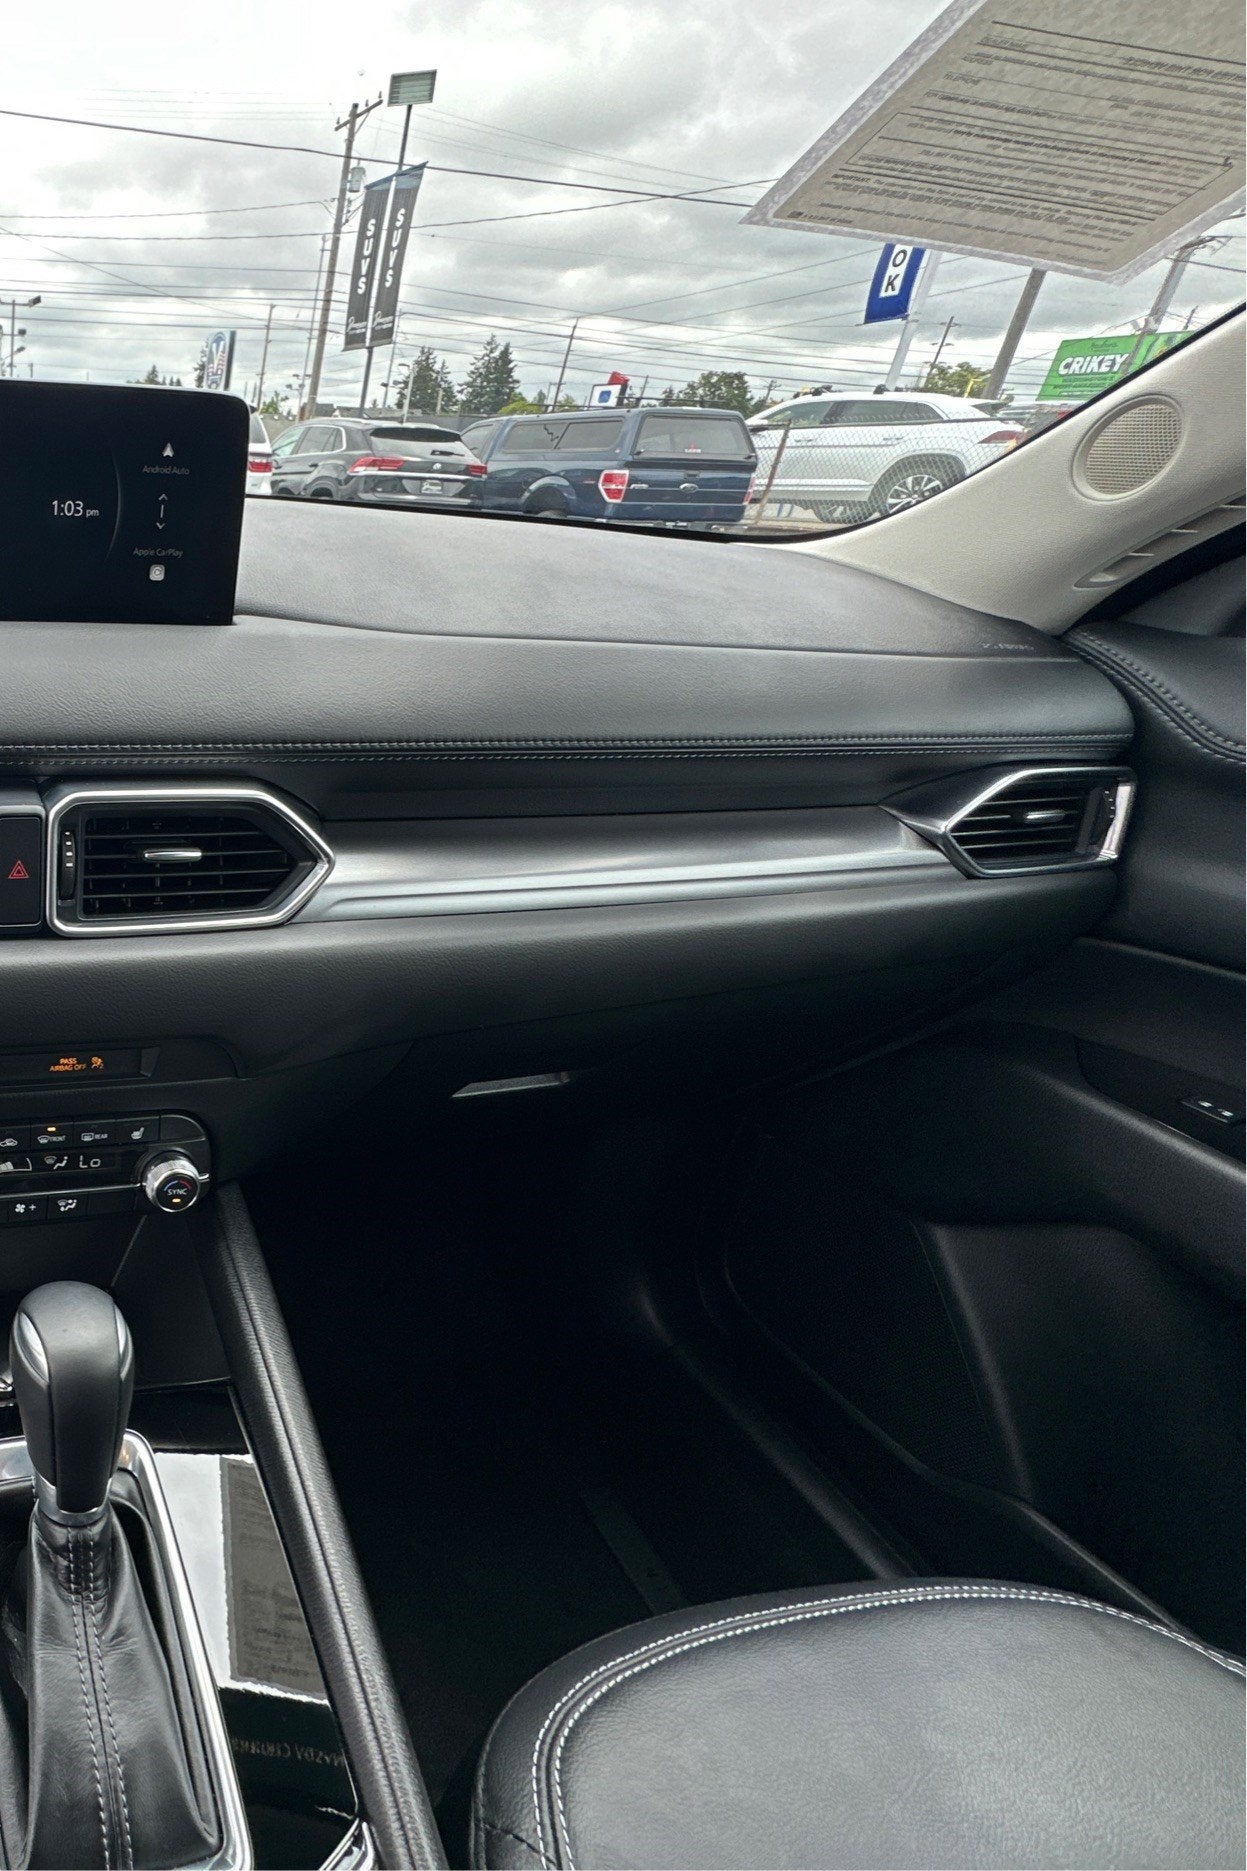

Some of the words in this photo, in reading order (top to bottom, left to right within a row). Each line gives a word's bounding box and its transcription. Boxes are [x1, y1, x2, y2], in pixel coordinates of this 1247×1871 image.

[385, 208, 405, 288] SUVS
[357, 219, 376, 294] SUVS
[1058, 353, 1129, 375] CRIKEY
[143, 465, 171, 474] Android
[172, 467, 189, 475] Auto
[52, 500, 83, 516] 1:03
[86, 509, 99, 518] pm
[133, 548, 153, 557] Apple
[156, 548, 183, 558] CarPlay
[59, 1057, 77, 1065] PASS
[49, 1064, 73, 1072] AIRBAG
[74, 1063, 87, 1071] OFF
[167, 1188, 187, 1196] SYNC
